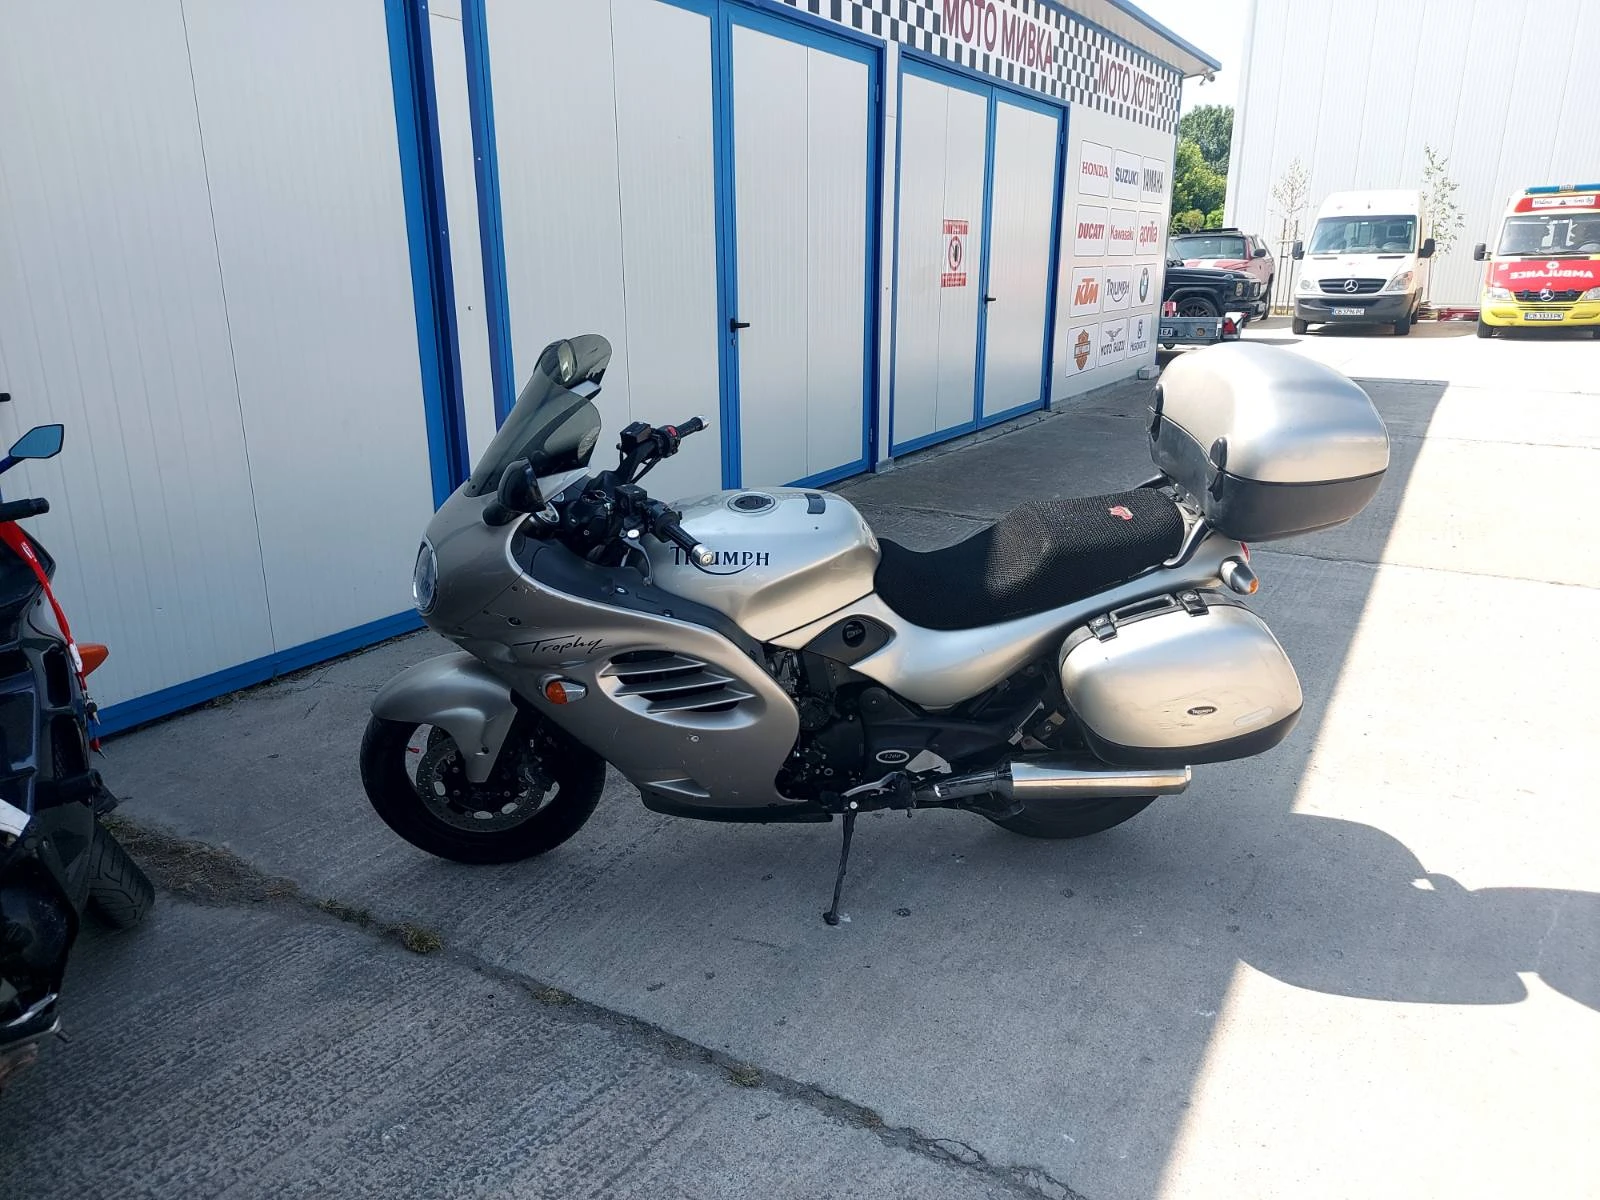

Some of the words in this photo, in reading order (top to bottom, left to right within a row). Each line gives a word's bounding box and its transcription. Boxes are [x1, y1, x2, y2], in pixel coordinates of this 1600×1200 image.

[942, 0, 997, 52] МОТО
[1002, 13, 1053, 75] МИВКА
[1098, 55, 1130, 102] МОТО
[1130, 70, 1161, 115] ХОТЕЛ
[1082, 161, 1108, 178] HONDA
[1115, 167, 1139, 186] SUZUKI
[1143, 167, 1163, 194] YAMAHA
[1078, 222, 1105, 240] DUCATI
[1109, 224, 1134, 241] Kawasaki
[1139, 221, 1158, 248] aprilia
[1074, 278, 1099, 306] KTM
[1106, 279, 1129, 296] TRIUMPH
[670, 547, 770, 566] TUMPH
[512, 635, 612, 654] Trophy
